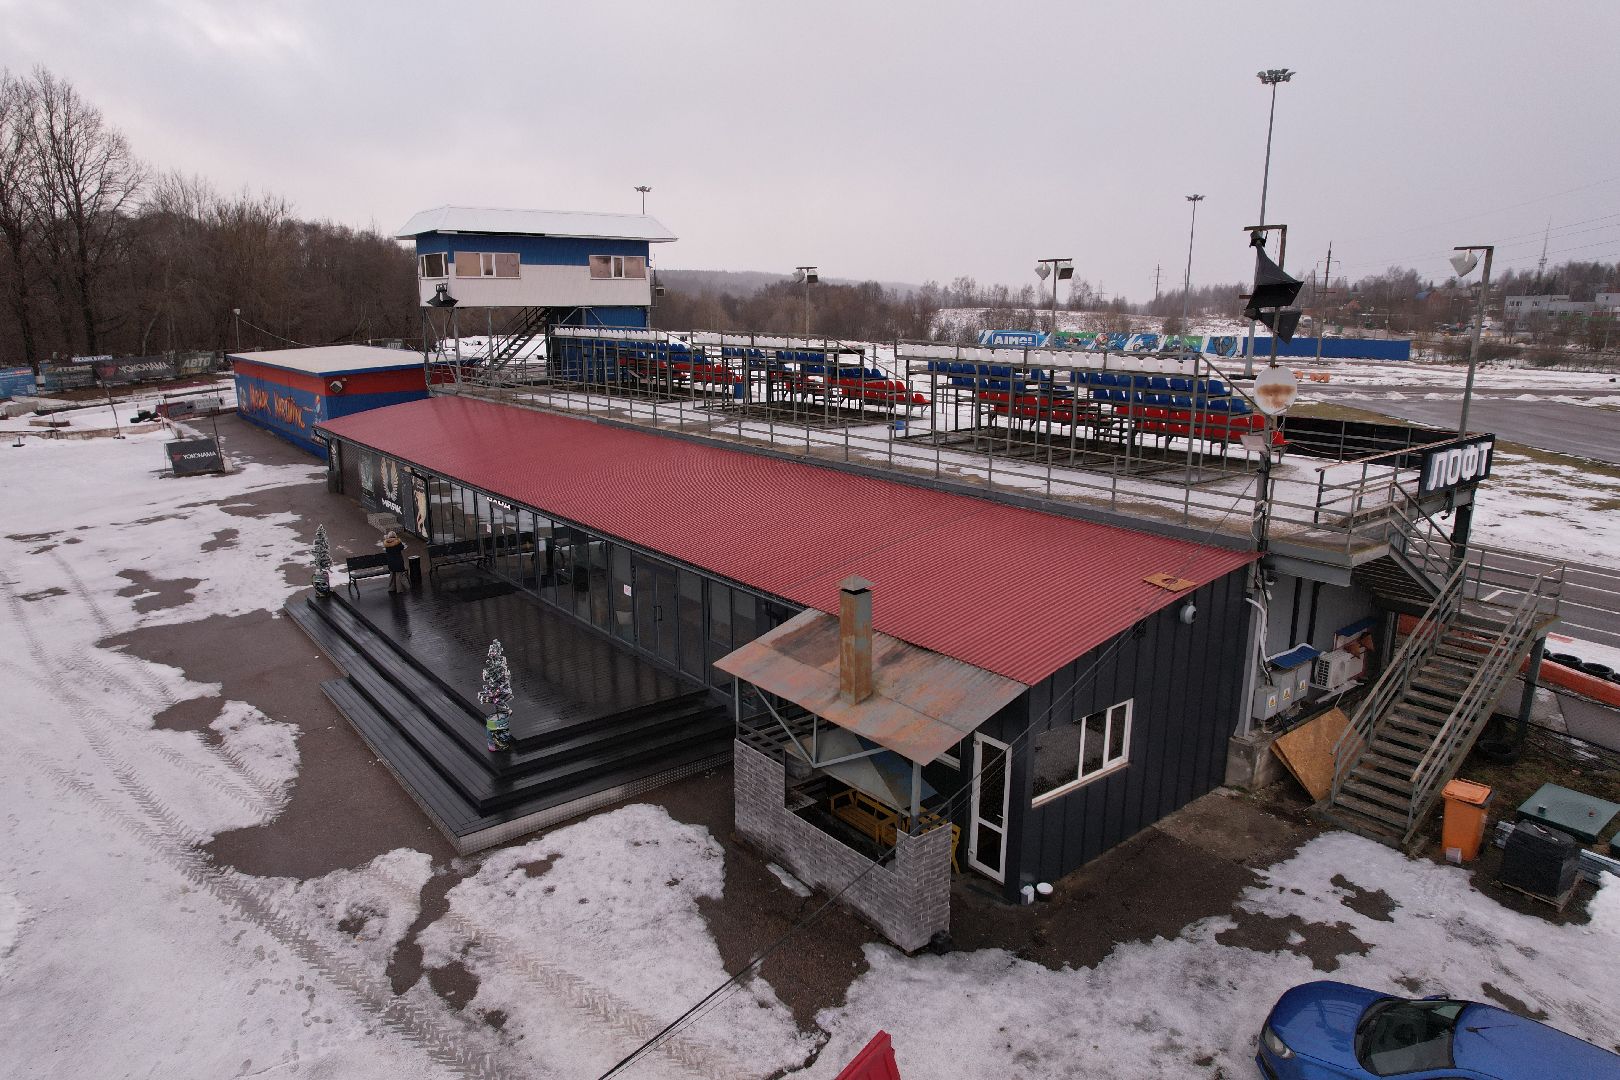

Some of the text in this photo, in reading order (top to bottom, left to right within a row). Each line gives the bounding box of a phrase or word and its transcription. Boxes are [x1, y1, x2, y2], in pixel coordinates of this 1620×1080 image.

[118, 361, 171, 373] YOKOHAMA
[183, 357, 210, 368] АВТО
[183, 450, 217, 460] YOKOHAMA
[1426, 441, 1493, 491] ЛОФТ
